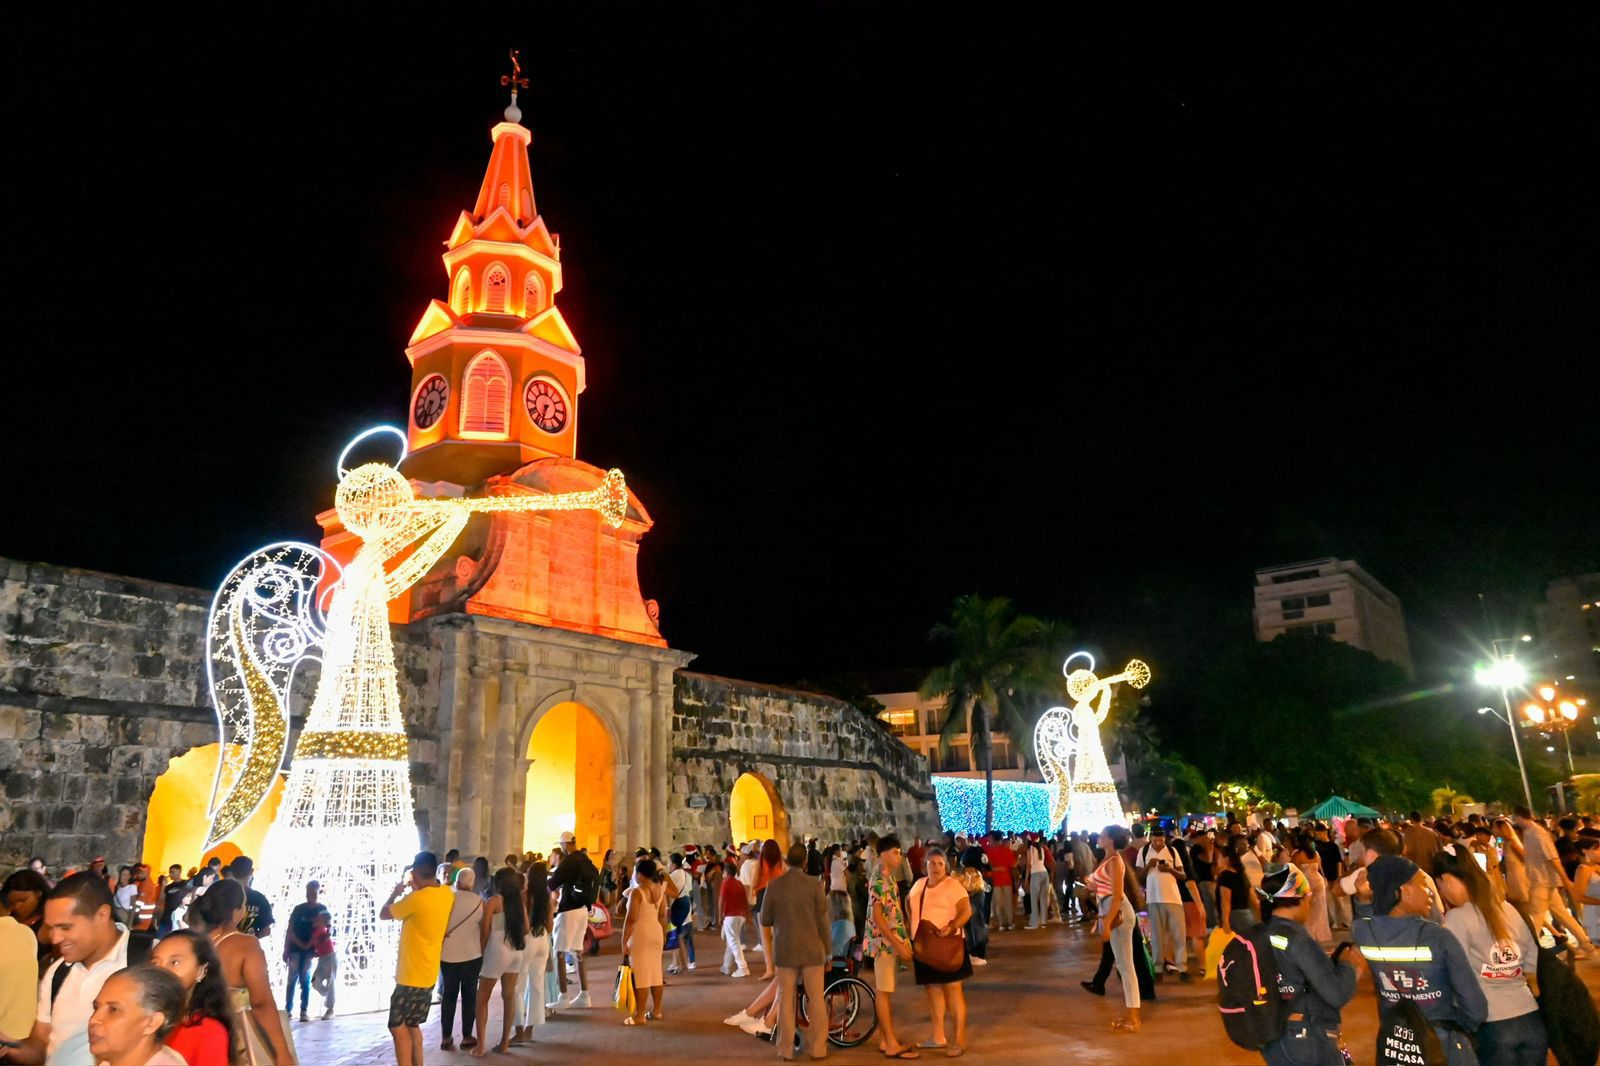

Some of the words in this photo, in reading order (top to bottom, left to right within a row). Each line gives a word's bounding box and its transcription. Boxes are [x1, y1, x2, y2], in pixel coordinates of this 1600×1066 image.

[1386, 1037, 1422, 1054] MELCOL
[1384, 1048, 1397, 1059] EN
[1397, 1053, 1425, 1065] CASA
